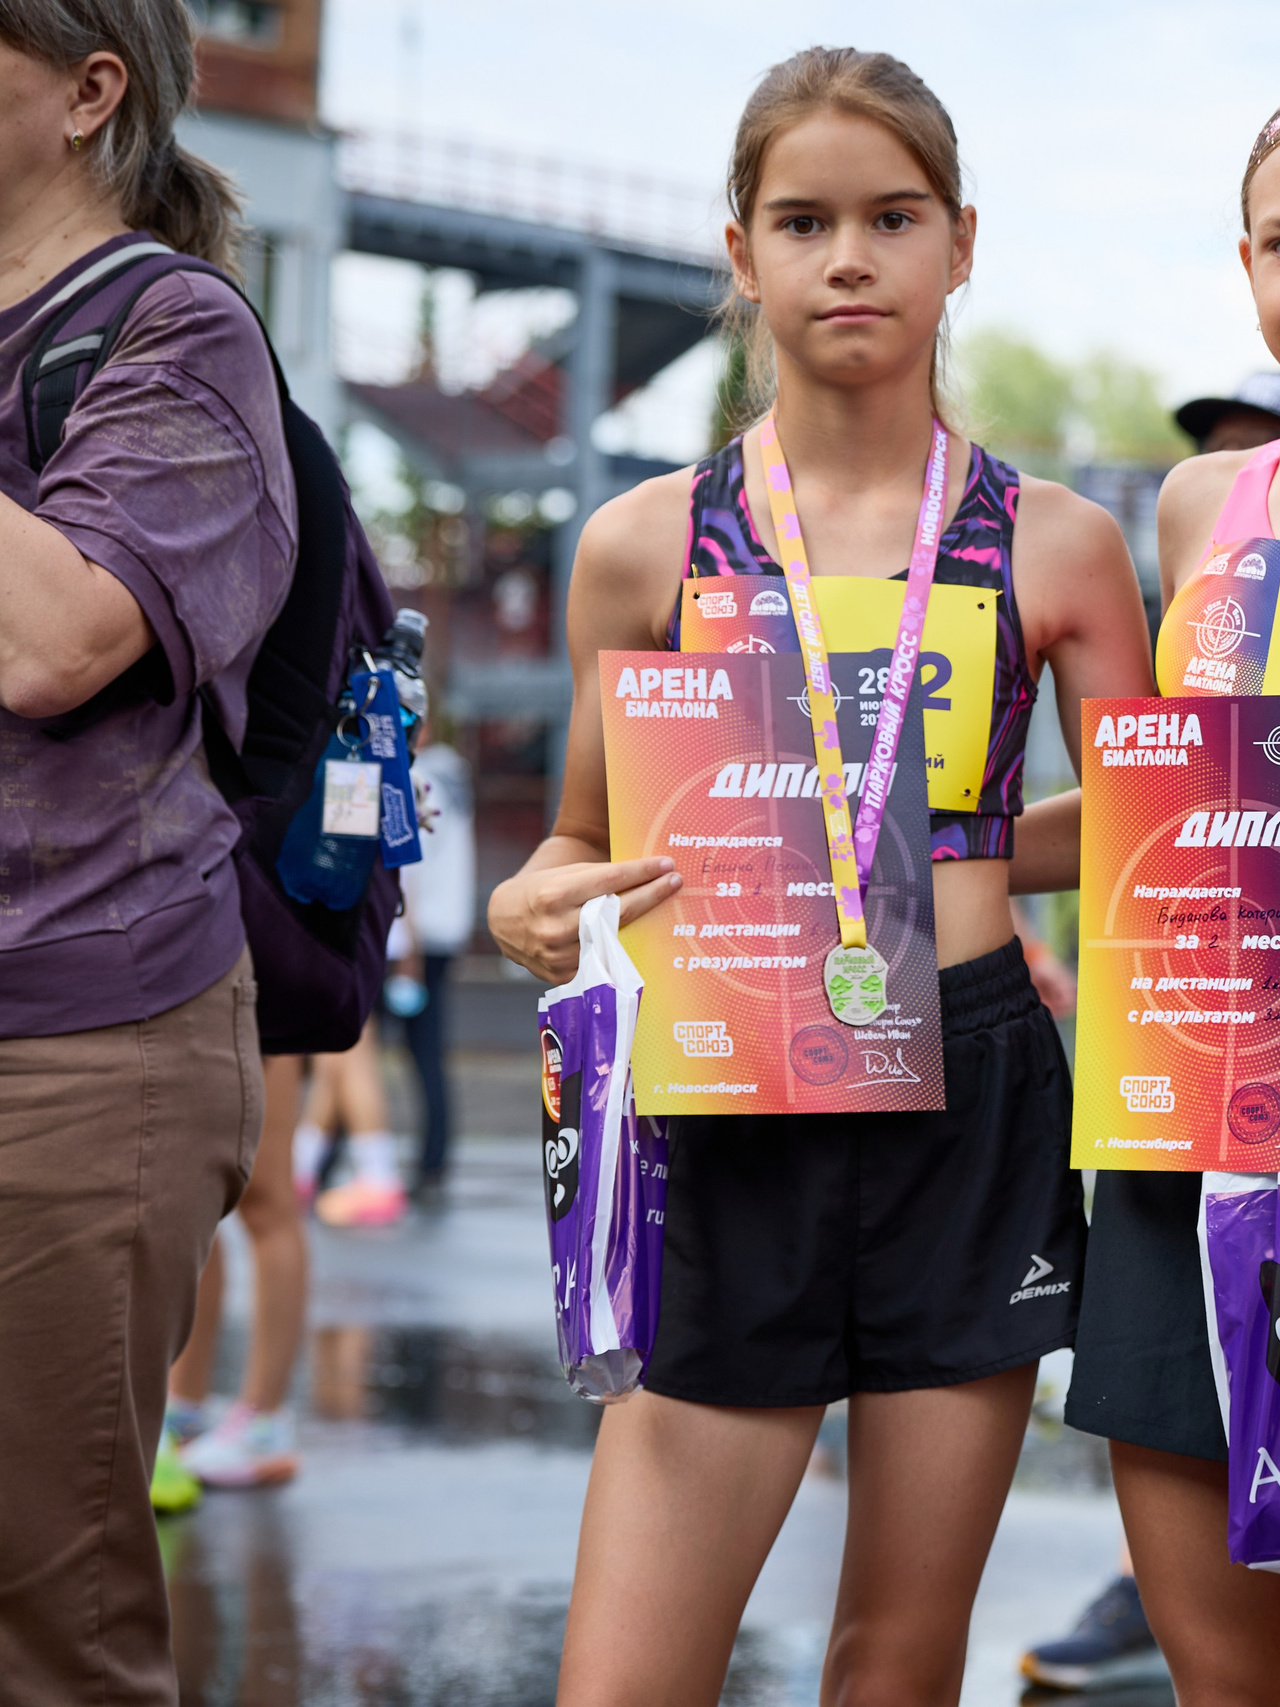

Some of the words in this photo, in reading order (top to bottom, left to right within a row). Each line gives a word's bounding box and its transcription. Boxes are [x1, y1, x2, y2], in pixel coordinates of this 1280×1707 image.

[920, 429, 948, 546] НОВОСИБИРСК
[700, 594, 730, 605] СПОРТ
[704, 604, 734, 615] СОЮЗ
[791, 582, 822, 647] ДЕТСКИЙ
[1186, 656, 1237, 681] АРЕНА
[615, 667, 733, 700] АРЕНА
[858, 667, 890, 695] 28
[1183, 674, 1233, 694] БИАТЛОНА
[625, 699, 719, 719] БИАТЛОНА
[864, 698, 902, 810] ПАРКОВЫЙ
[889, 630, 918, 701] КРОСС
[1093, 713, 1203, 747] АРЕНА
[1102, 748, 1188, 767] БИАТЛОНА
[668, 833, 783, 849] Награждается
[715, 882, 742, 897] за
[786, 882, 836, 897] мест
[1133, 885, 1242, 900] Награждается
[673, 924, 695, 937] на
[699, 924, 801, 938] дистанции
[1174, 935, 1200, 949] за
[1208, 934, 1220, 949] 2
[673, 957, 683, 969] с
[688, 955, 807, 972] результатом
[1131, 978, 1153, 991] на
[1155, 977, 1253, 991] дистанции
[1127, 1011, 1140, 1023] с
[1141, 1009, 1255, 1026] результатом
[677, 1024, 724, 1039] СПОРТ
[686, 1039, 730, 1054] СОЮЗ
[653, 1084, 664, 1095] г.
[667, 1081, 758, 1096] Новосибирск
[1124, 1079, 1167, 1094] СПОРТ
[1130, 1094, 1171, 1109] СОЮЗ
[1241, 1105, 1265, 1116] СПОРТ
[1095, 1137, 1104, 1147] г.
[1107, 1137, 1193, 1152] Новосибирск
[1009, 1281, 1071, 1305] DEMIX
